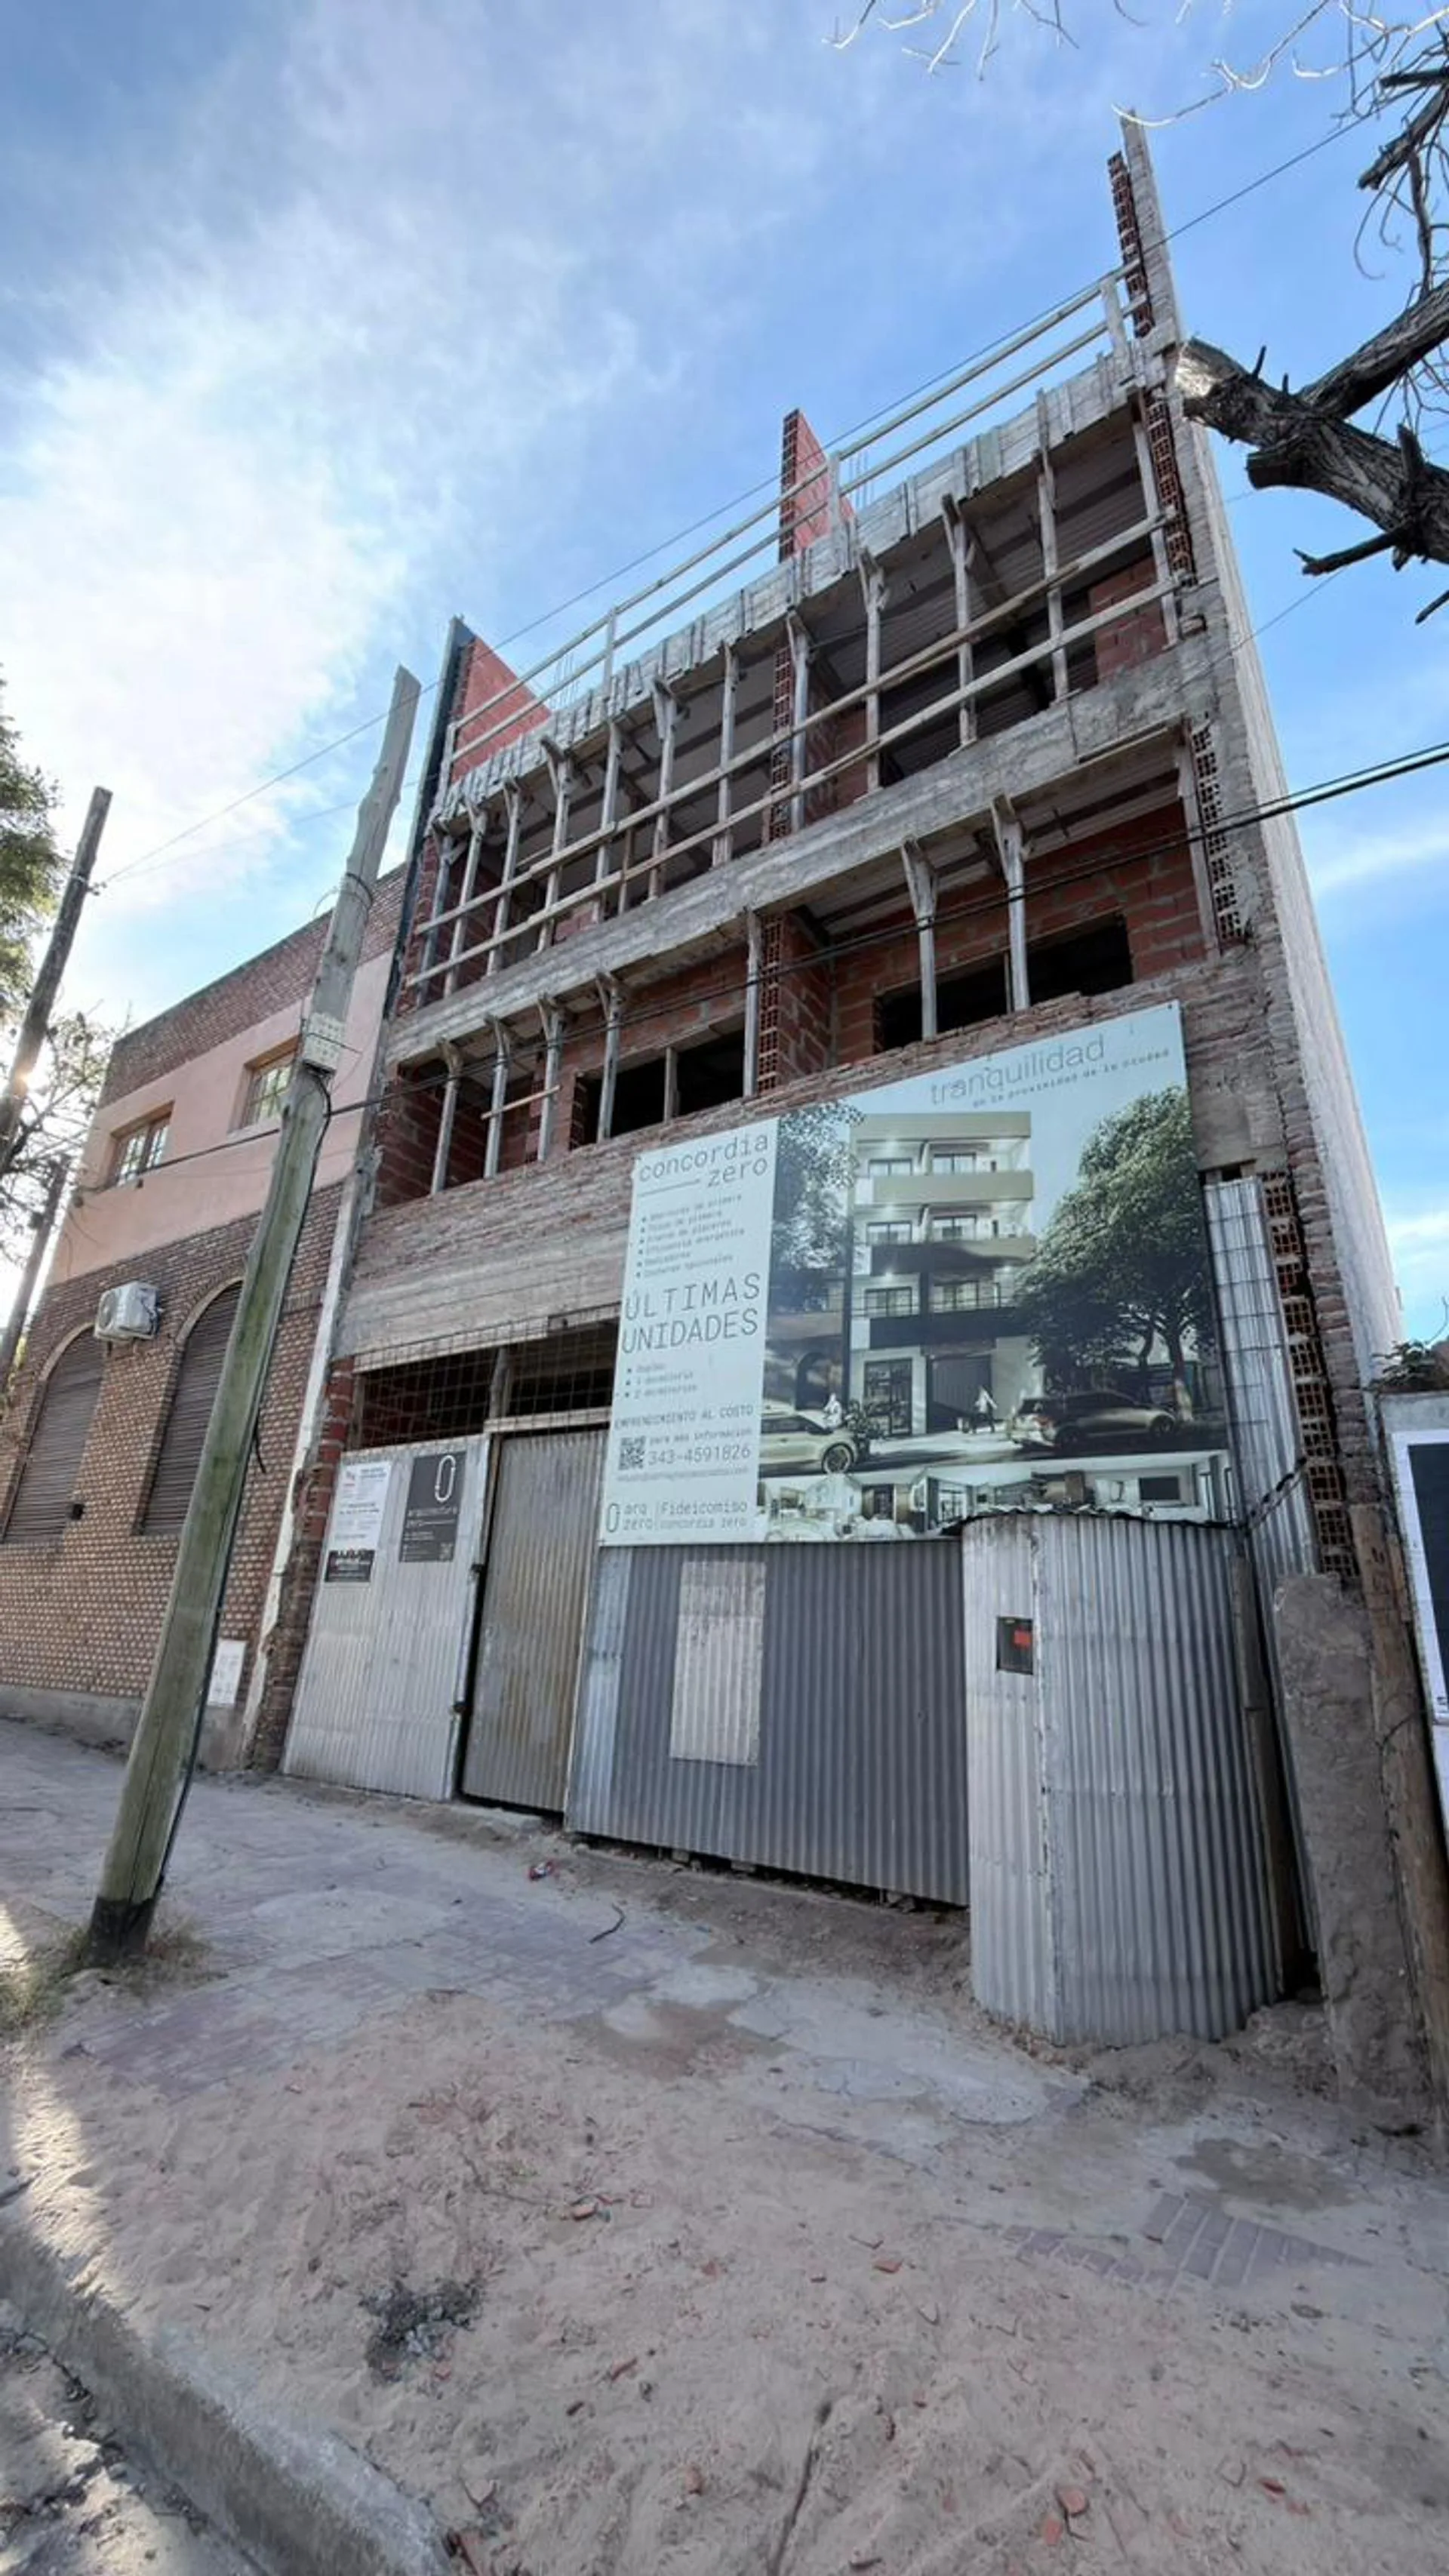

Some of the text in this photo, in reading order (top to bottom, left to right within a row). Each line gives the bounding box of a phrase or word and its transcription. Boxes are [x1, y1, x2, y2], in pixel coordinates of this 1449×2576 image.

[931, 1033, 1104, 1105] tranquilidad
[639, 1134, 768, 1183] concordia
[708, 1157, 768, 1188] zero
[622, 1307, 758, 1354] UNIDADES
[648, 1444, 751, 1465] 343-4591826
